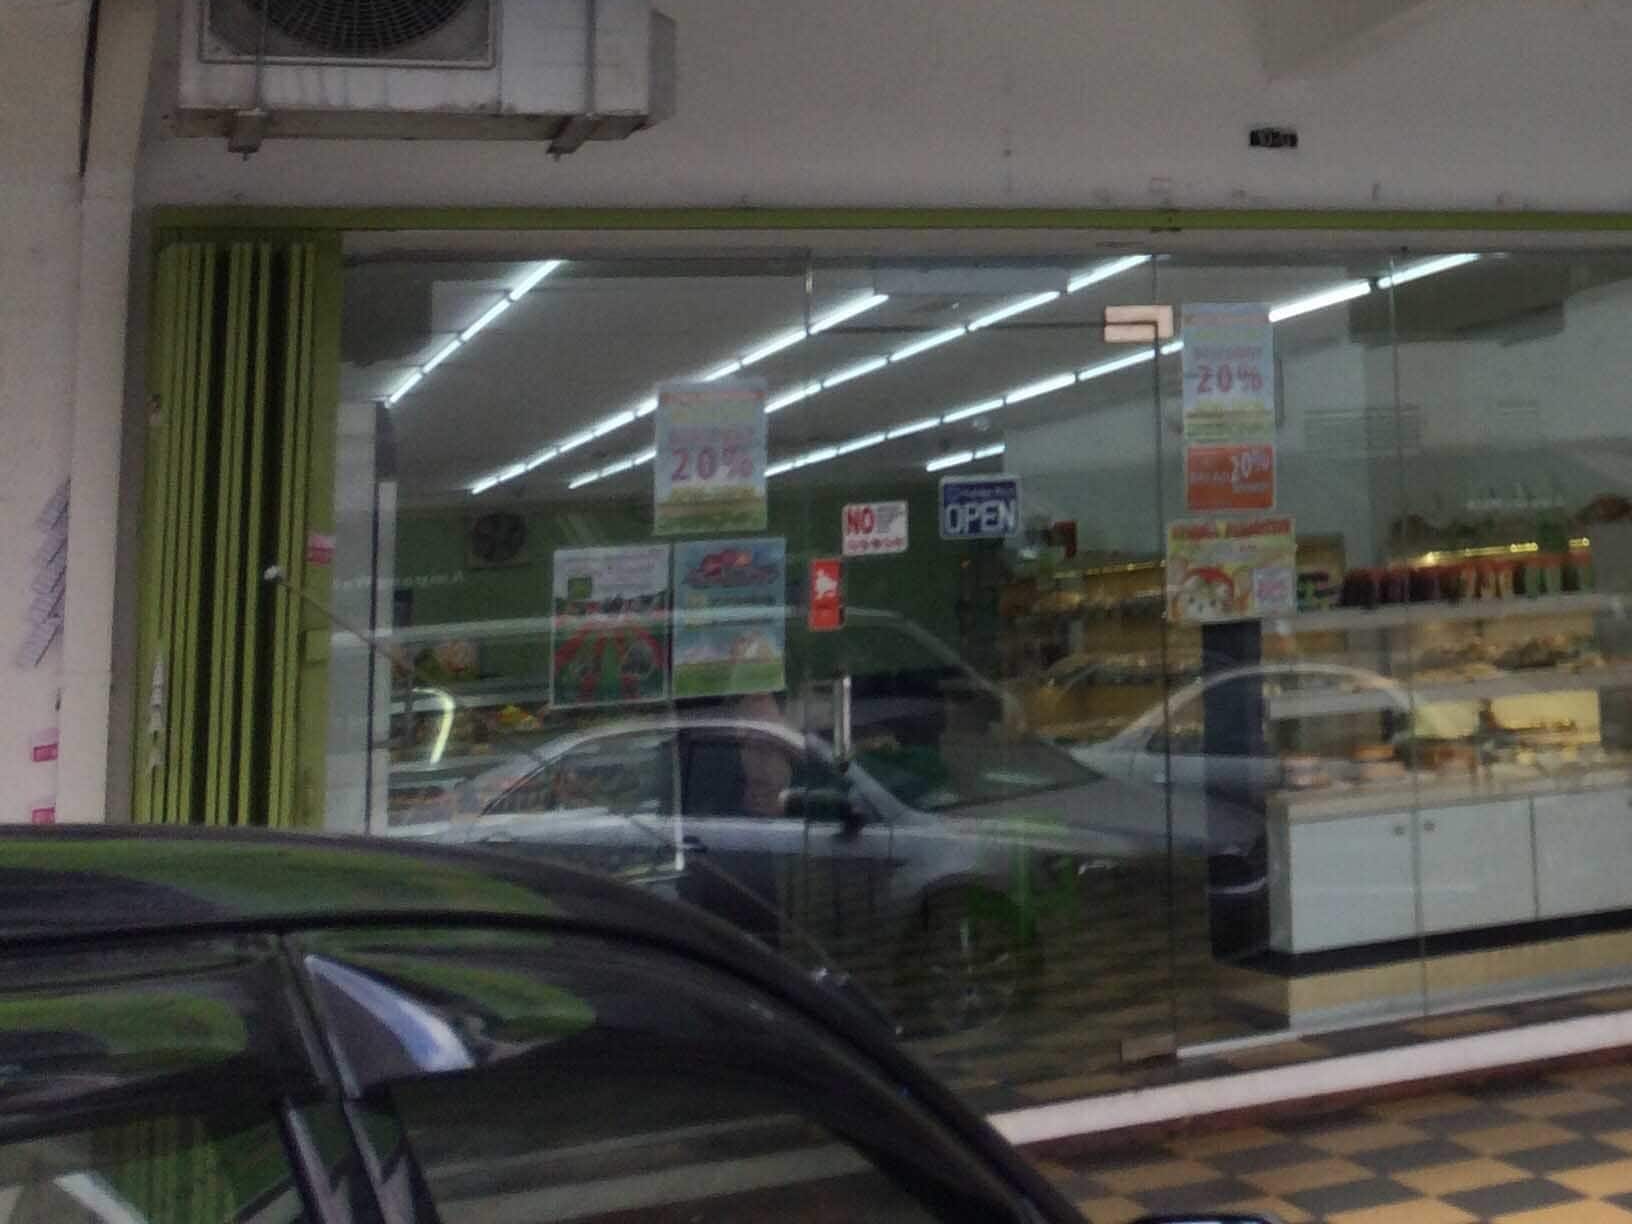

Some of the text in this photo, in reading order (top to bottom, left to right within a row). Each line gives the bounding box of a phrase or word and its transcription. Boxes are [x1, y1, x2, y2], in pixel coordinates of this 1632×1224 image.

[1197, 363, 1264, 394] 20%
[671, 441, 753, 481] 20%
[846, 506, 876, 534] NO
[944, 499, 1017, 536] OPEN
